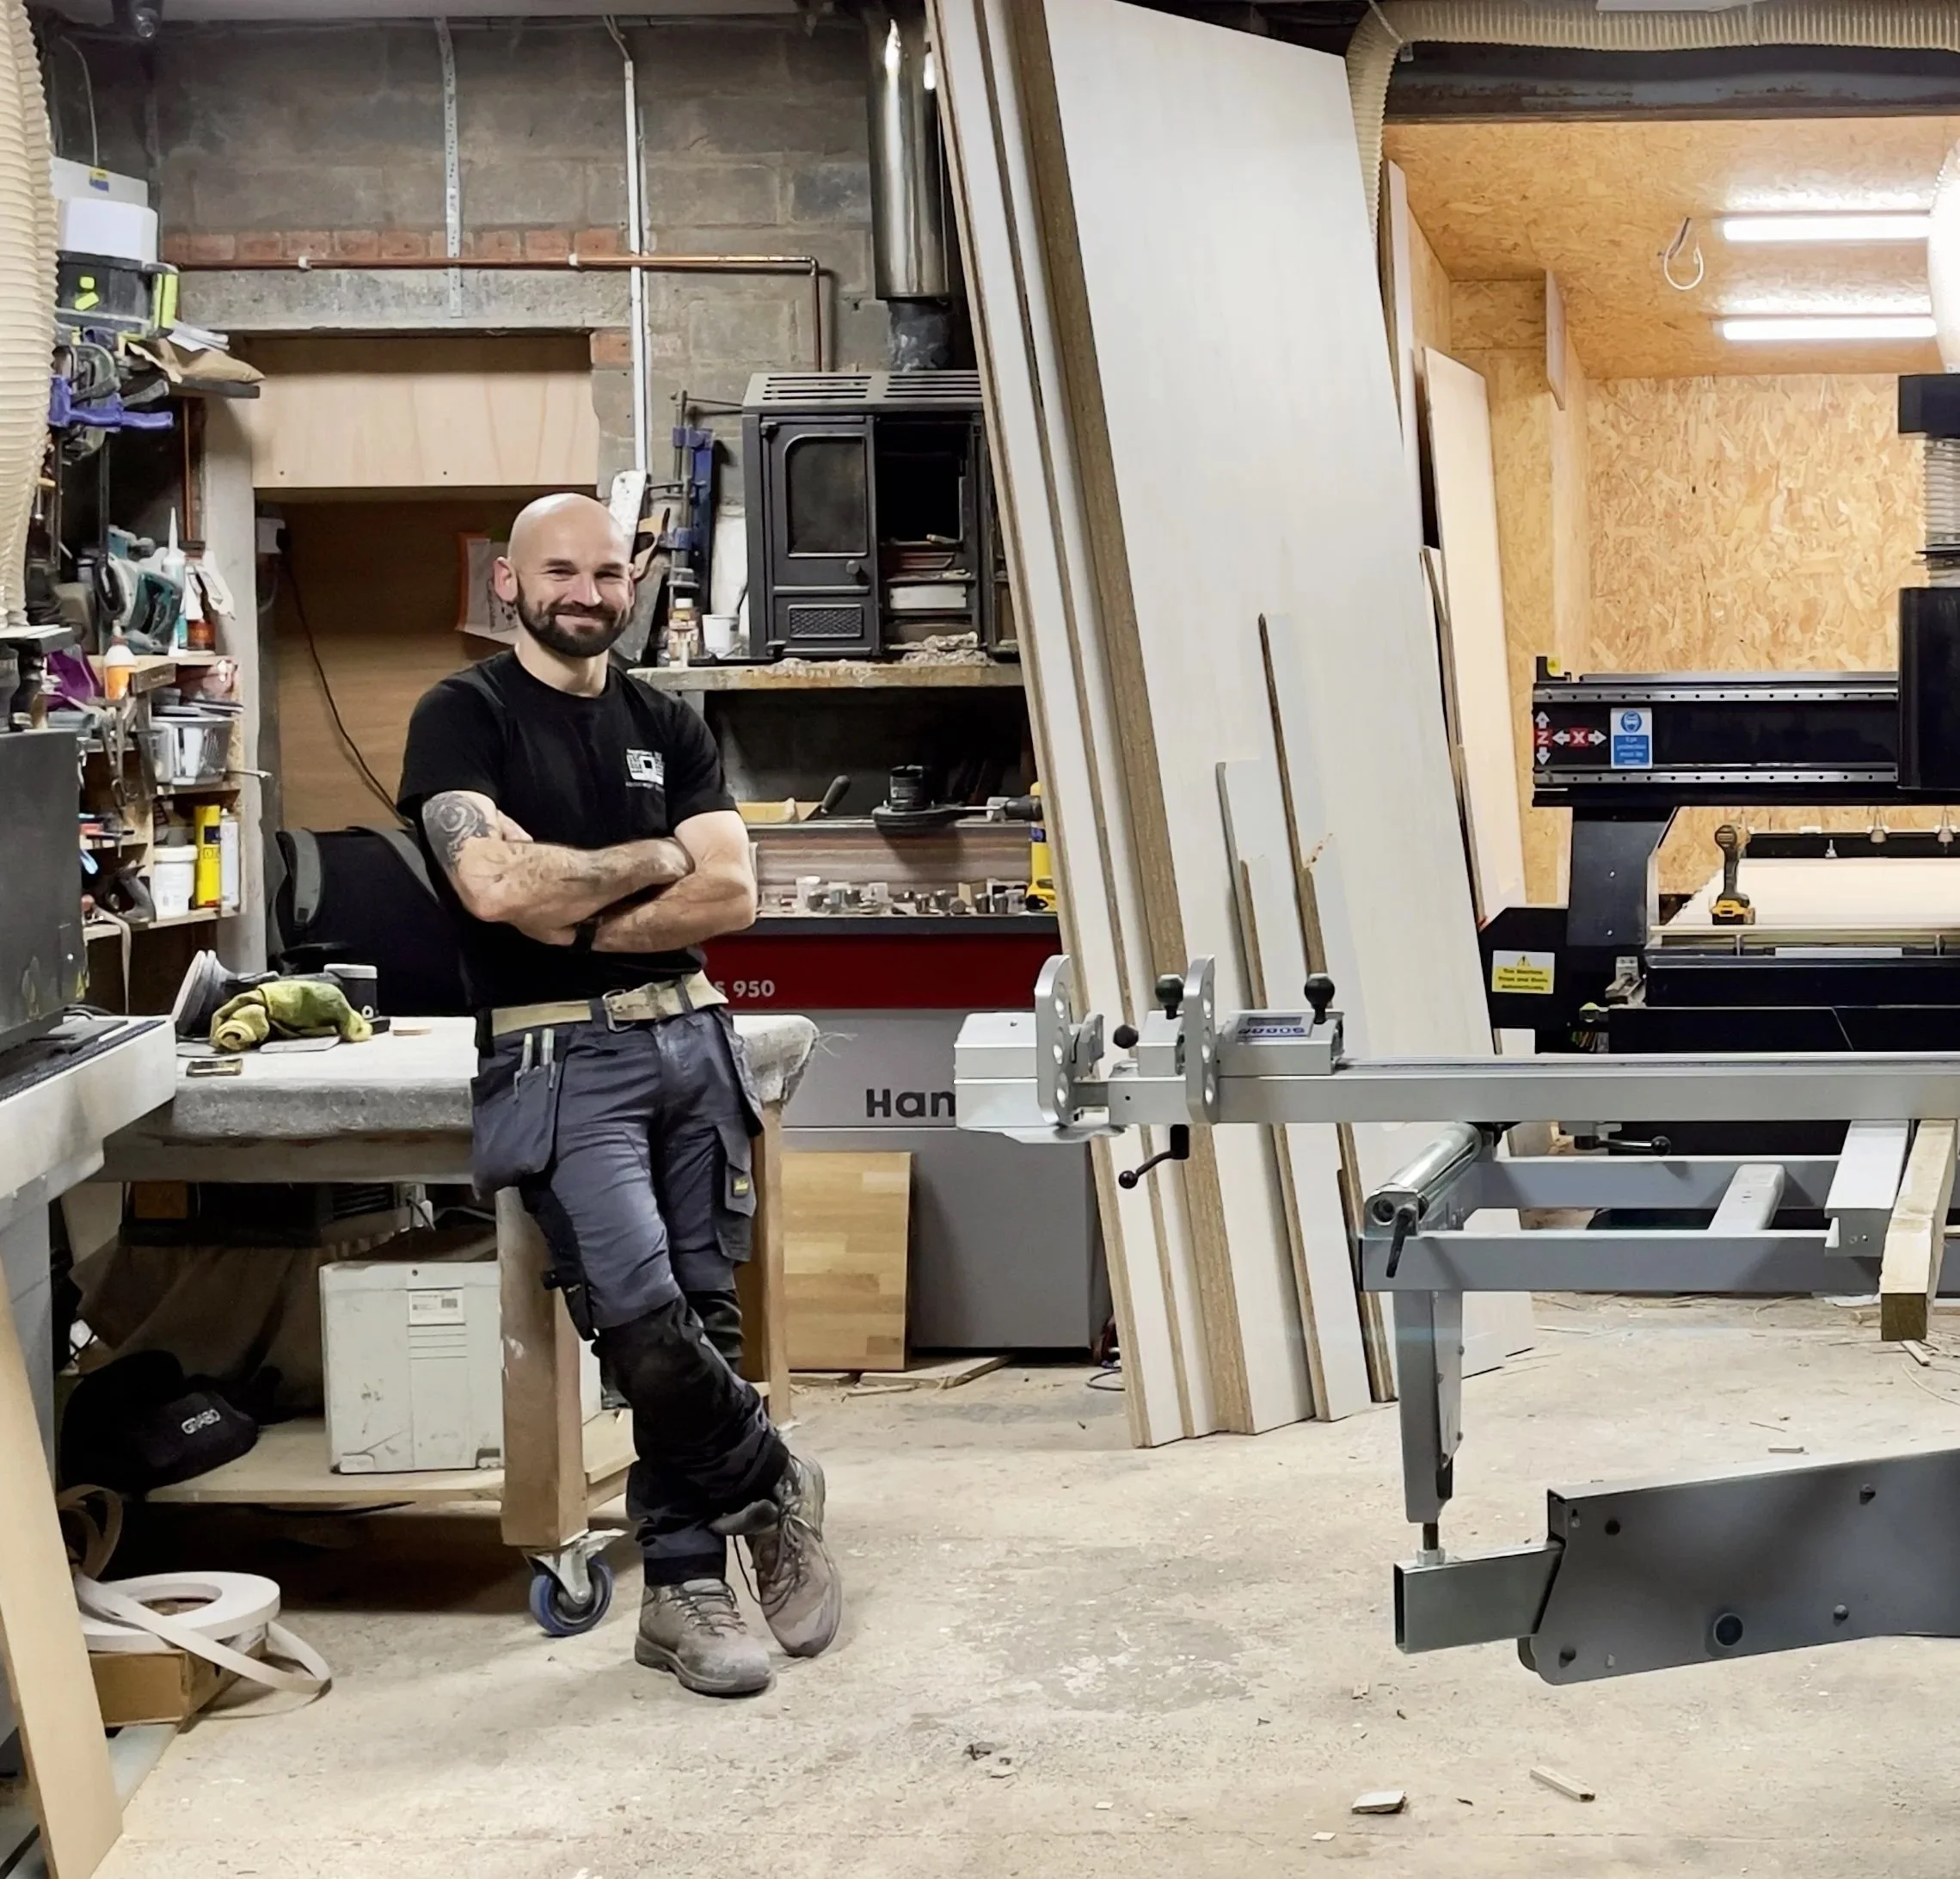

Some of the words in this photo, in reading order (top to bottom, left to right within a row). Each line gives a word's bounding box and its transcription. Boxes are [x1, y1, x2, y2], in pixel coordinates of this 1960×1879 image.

[1537, 730, 1550, 746] Z
[1572, 731, 1586, 745] X
[733, 979, 776, 998] 950
